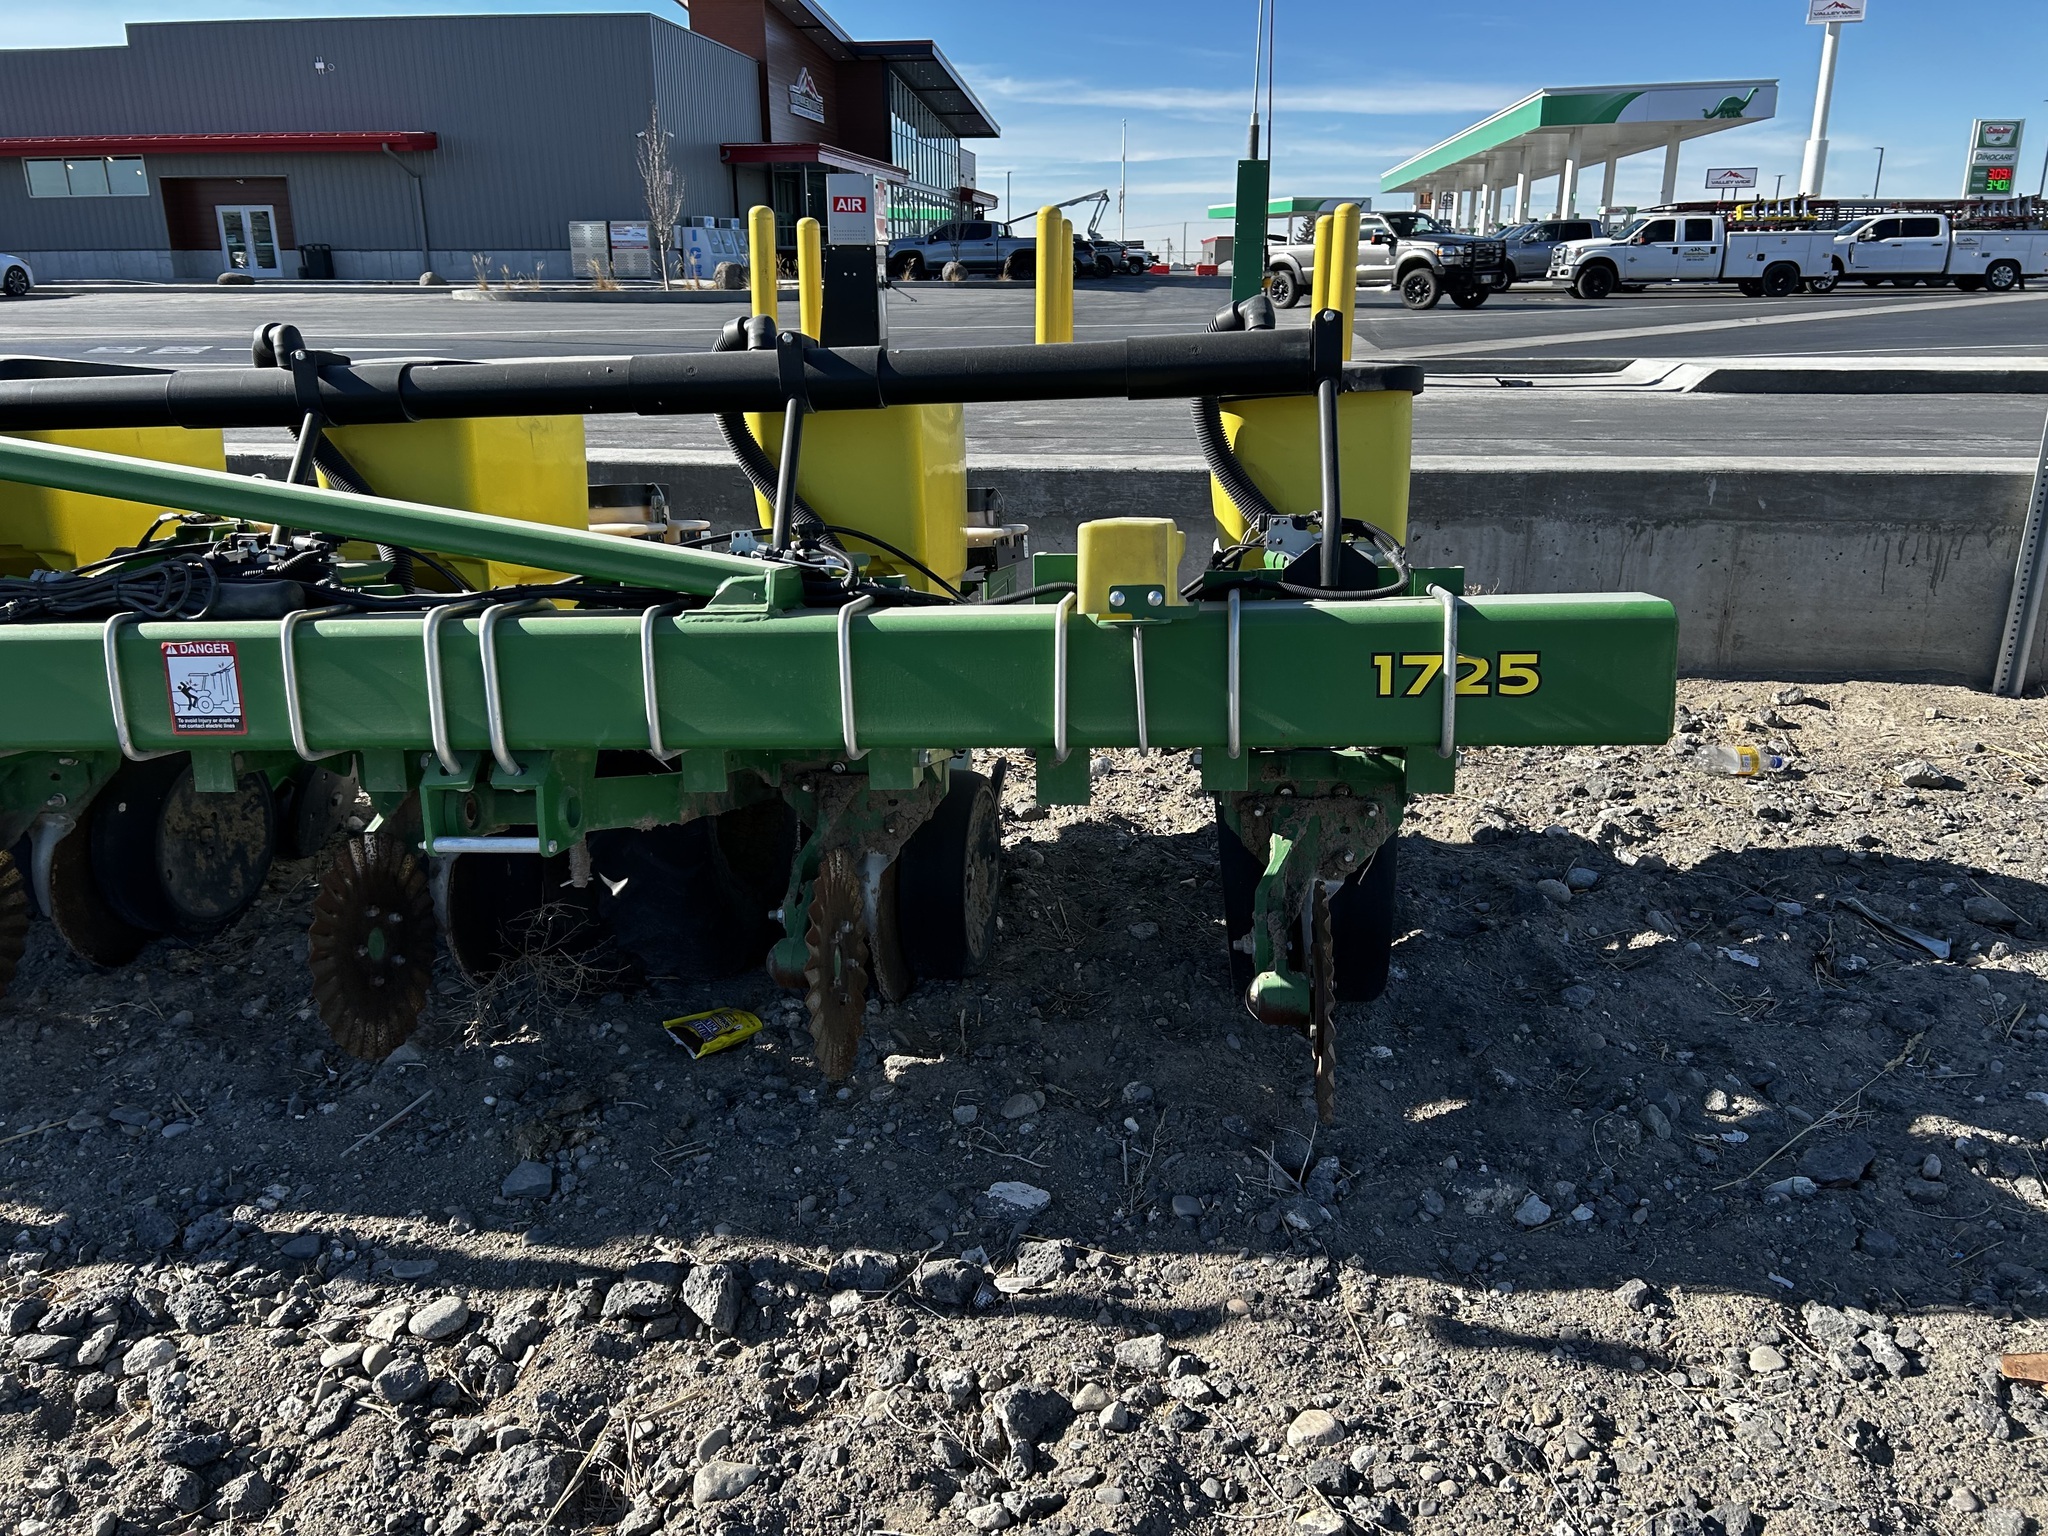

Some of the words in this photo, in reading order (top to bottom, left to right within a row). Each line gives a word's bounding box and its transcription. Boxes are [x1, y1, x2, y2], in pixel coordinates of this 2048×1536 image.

[836, 198, 863, 212] AIR
[180, 643, 230, 654] DANGER
[1371, 651, 1542, 698] 1725
